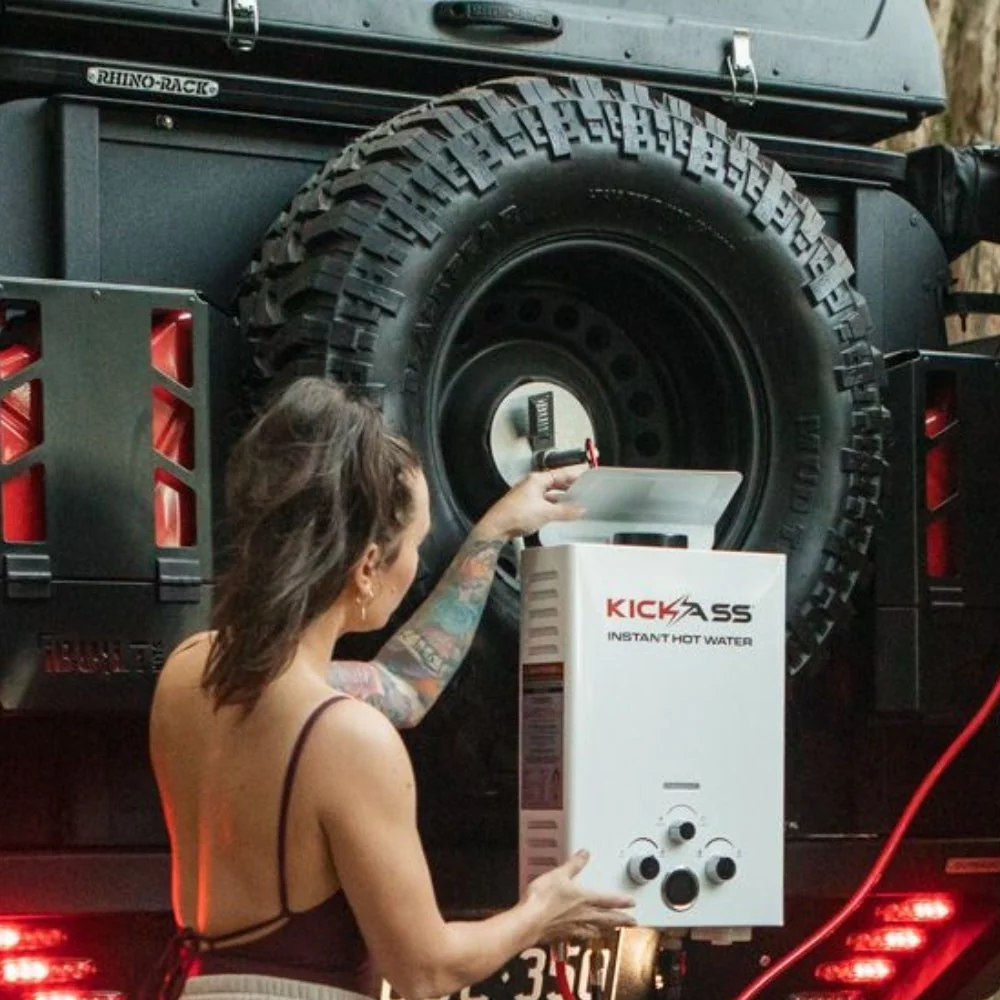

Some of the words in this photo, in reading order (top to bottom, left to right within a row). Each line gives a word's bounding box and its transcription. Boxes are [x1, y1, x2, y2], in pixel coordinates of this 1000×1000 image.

[97, 69, 209, 95] RHINO-RACK
[606, 594, 753, 627] KICKASS
[607, 631, 669, 643] INSTANT
[671, 634, 702, 645] HOT
[704, 635, 753, 647] WATER
